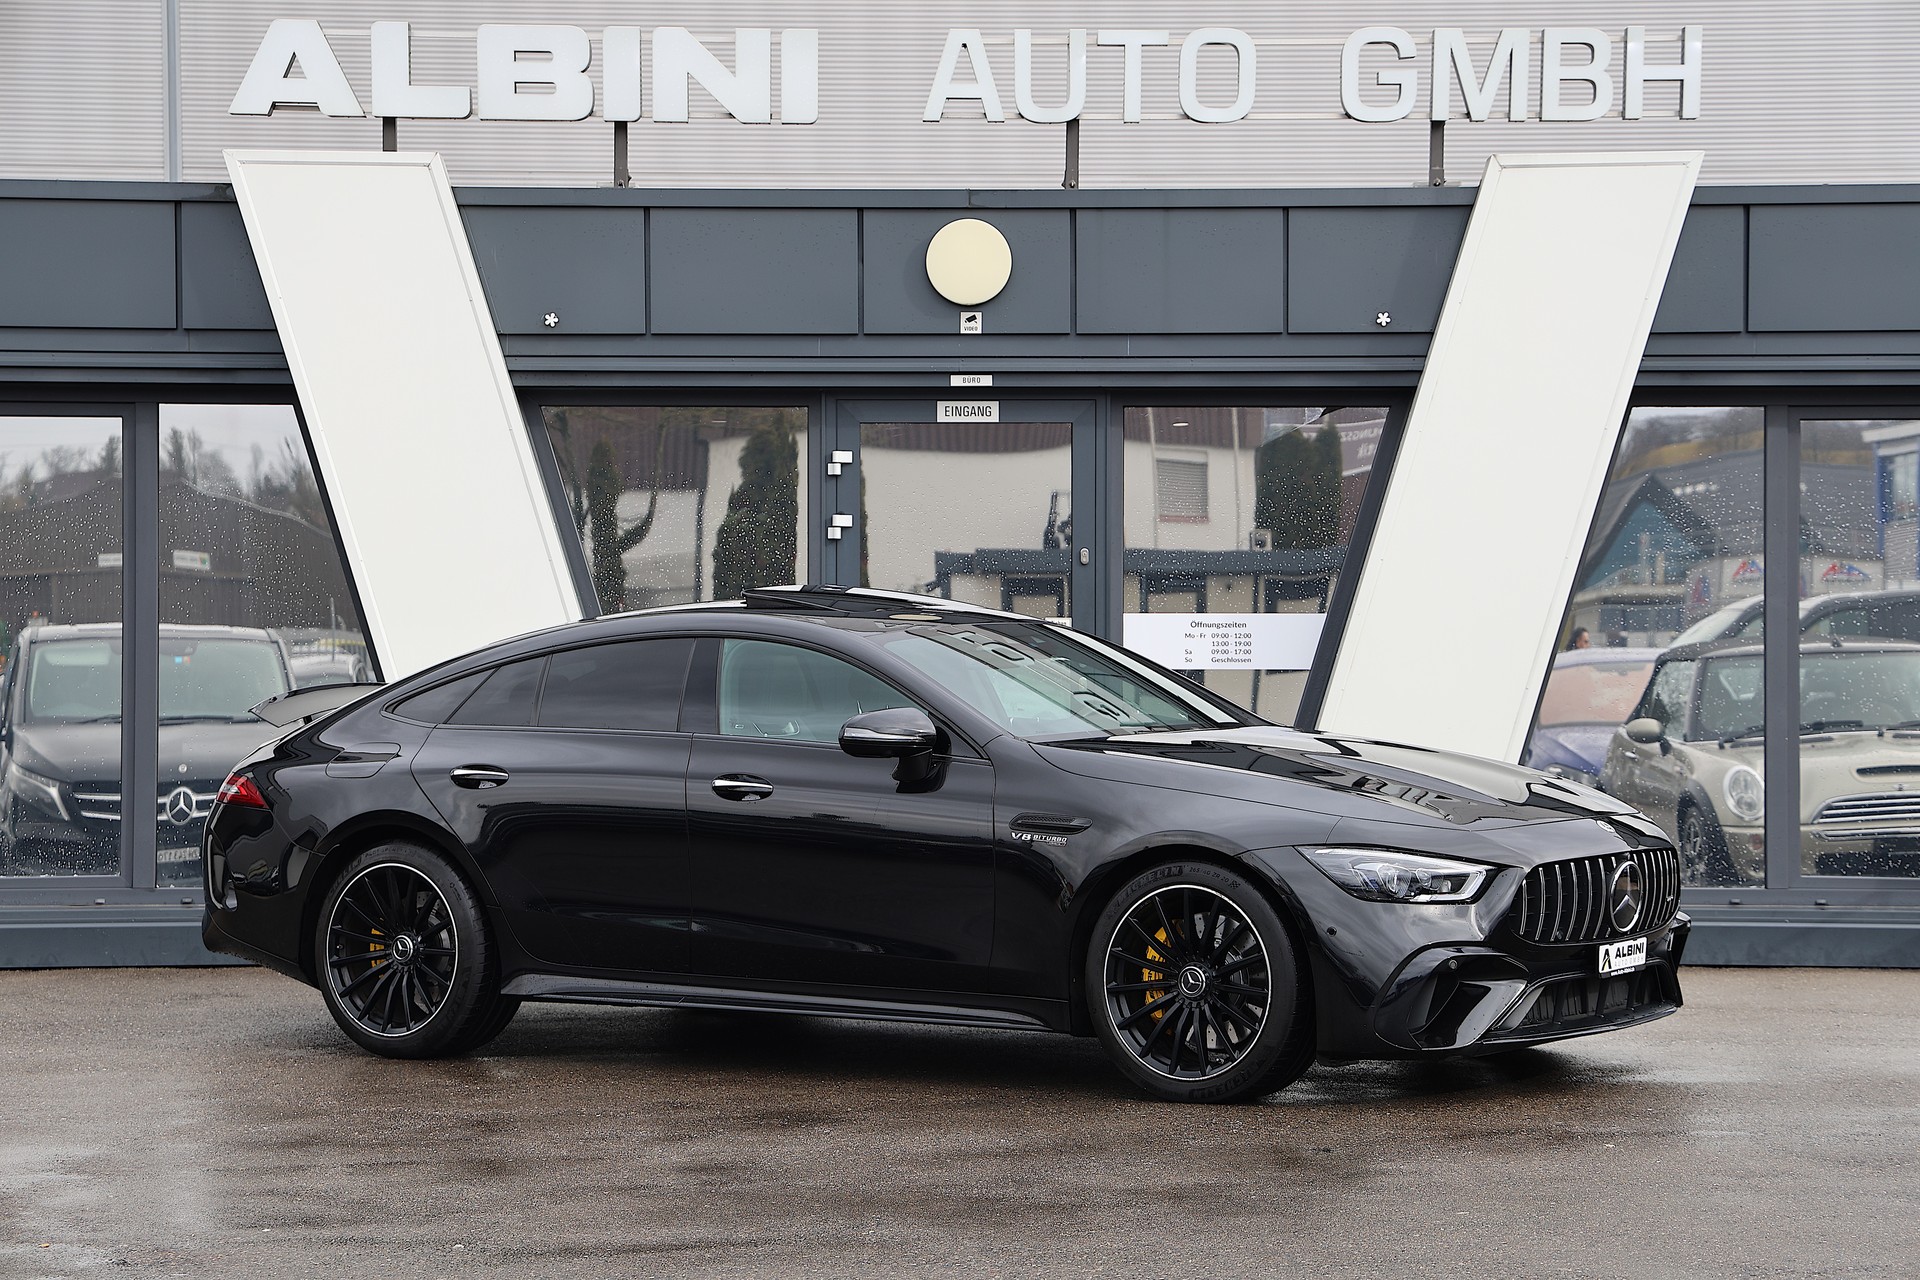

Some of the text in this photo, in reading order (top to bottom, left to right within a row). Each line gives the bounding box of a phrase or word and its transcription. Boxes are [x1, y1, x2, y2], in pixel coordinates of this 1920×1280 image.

[228, 19, 1704, 124] ALBINI AUTO GMBH
[962, 376, 981, 384] BÜRO
[944, 405, 992, 417] EINGANG
[1190, 620, 1247, 629] Öffnungszeiten
[1011, 832, 1068, 842] V8 BITURBO
[1615, 942, 1645, 959] ALBINI
